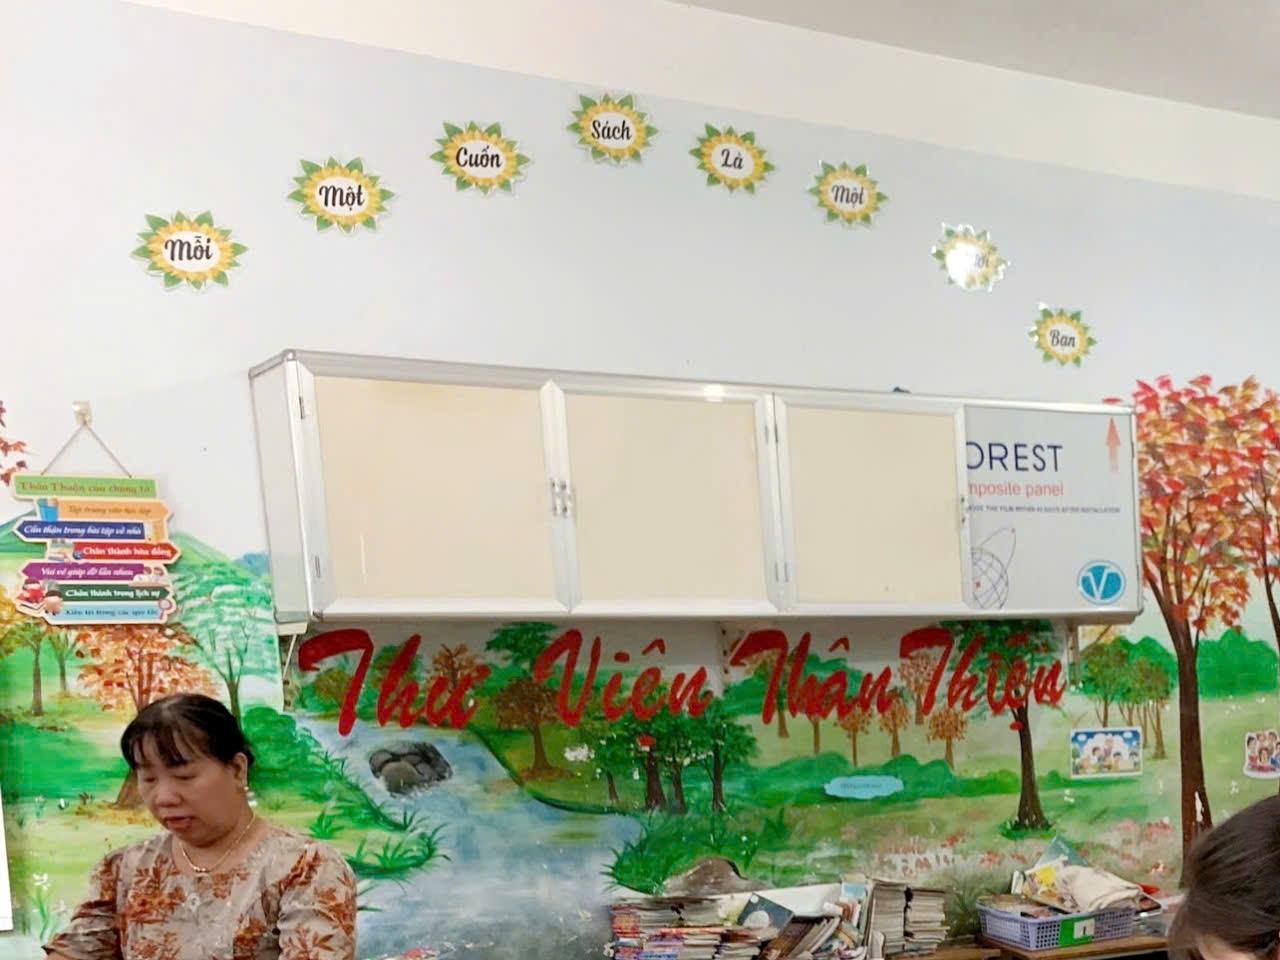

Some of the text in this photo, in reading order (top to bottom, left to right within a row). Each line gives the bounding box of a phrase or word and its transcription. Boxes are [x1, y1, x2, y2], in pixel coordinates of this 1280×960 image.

[164, 118, 1076, 351] Mỗi Một Cuốn Sách Là Một Bạn
[1025, 481, 1064, 499] panel
[299, 629, 490, 736] Thư
[730, 630, 895, 726] Thân
